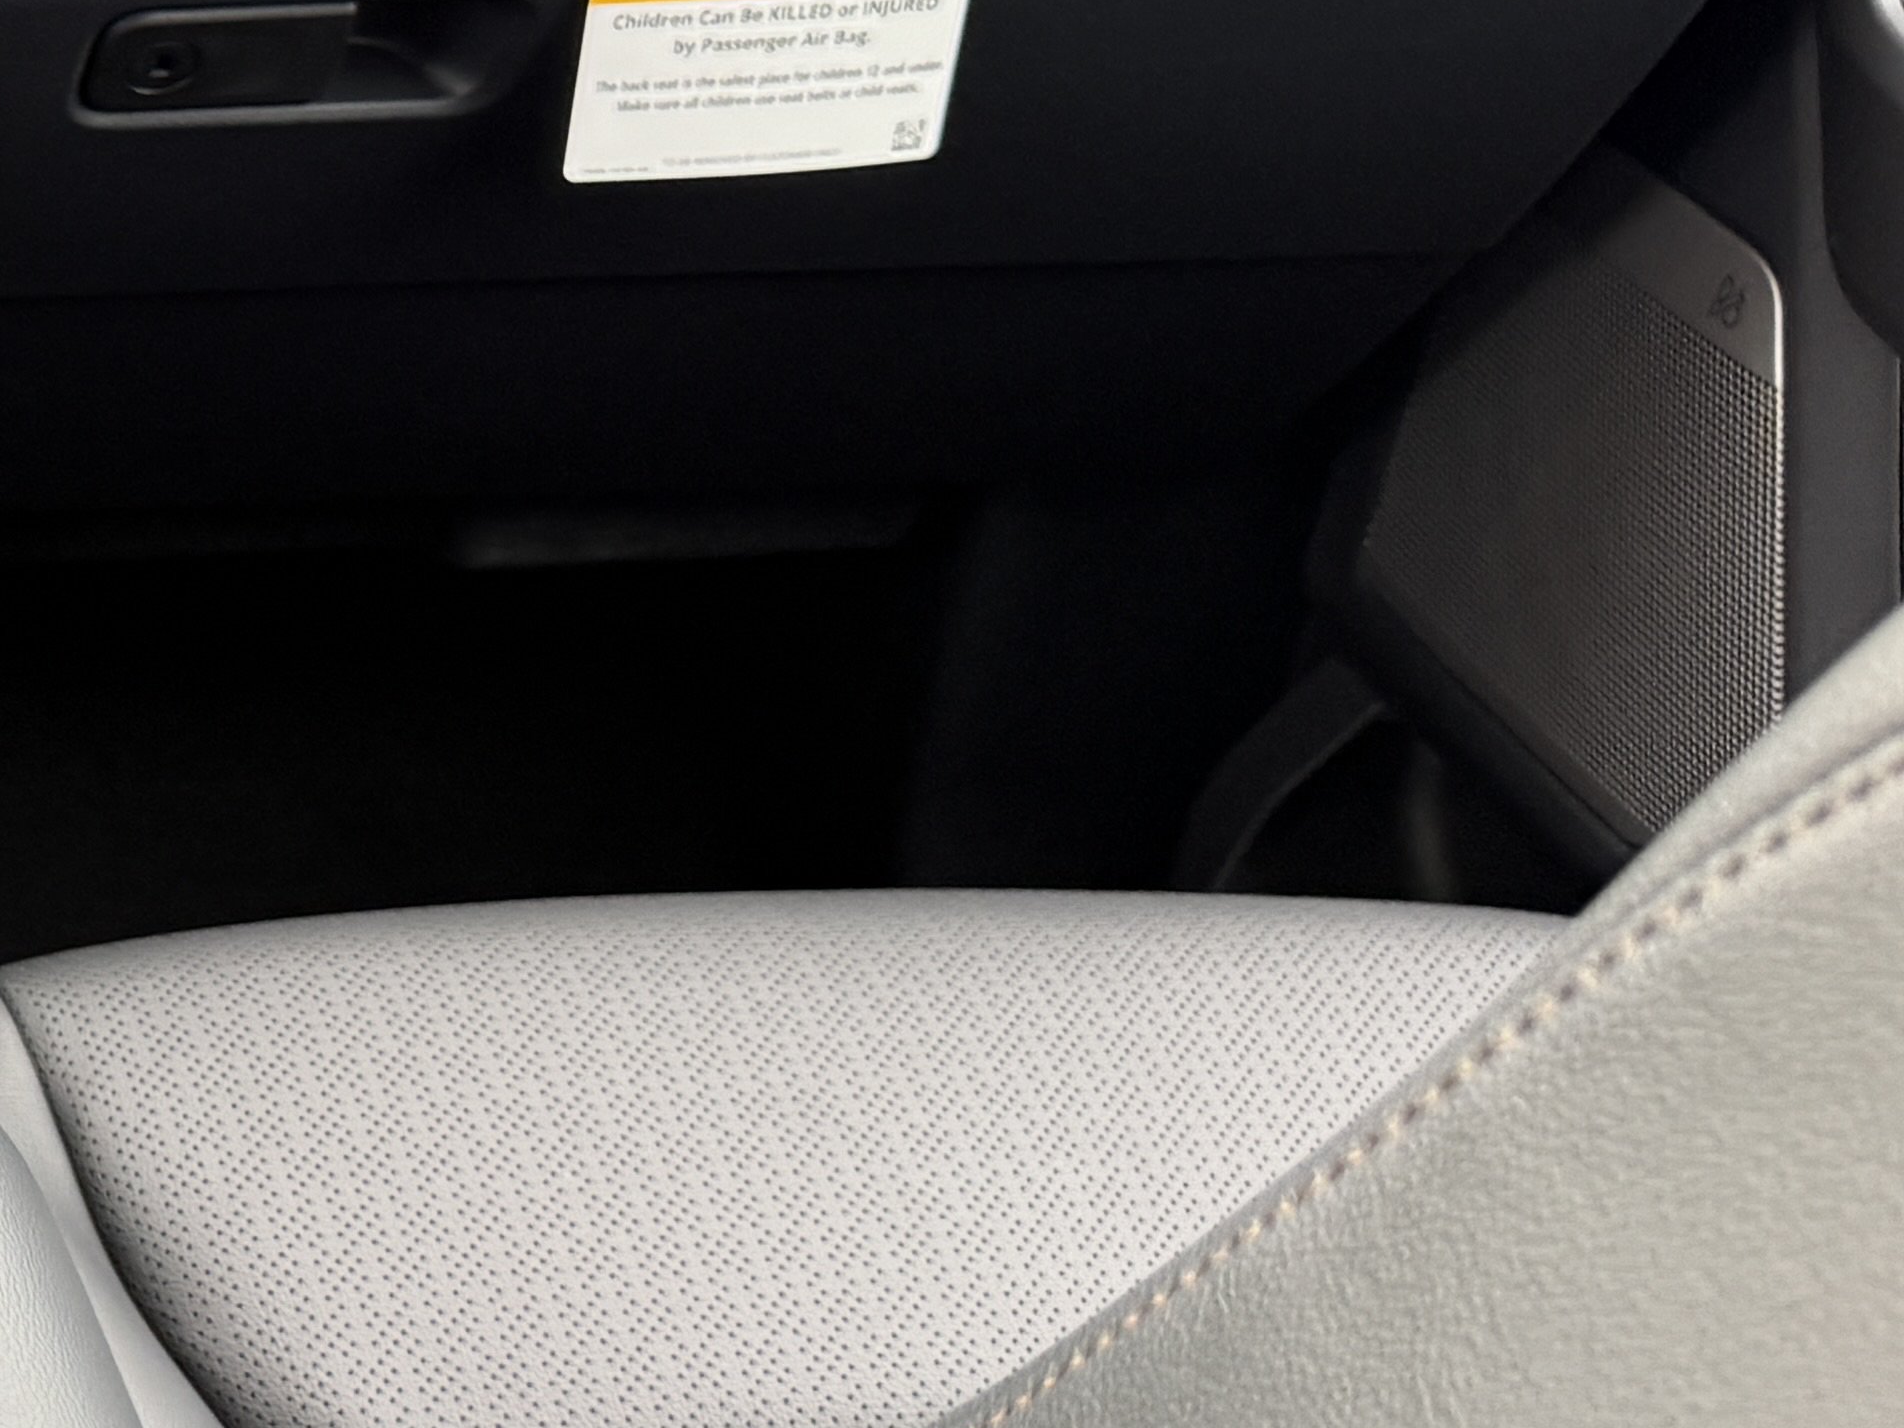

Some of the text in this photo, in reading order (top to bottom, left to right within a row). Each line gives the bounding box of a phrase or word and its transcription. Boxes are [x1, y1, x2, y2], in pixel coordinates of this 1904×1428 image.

[613, 10, 693, 31] Children
[699, 9, 735, 28] Can
[740, 8, 764, 24] Be
[768, 5, 833, 22] KILLED
[838, 3, 858, 17] or
[673, 39, 696, 56] by
[701, 34, 797, 54] Passenger
[801, 31, 828, 47] Air
